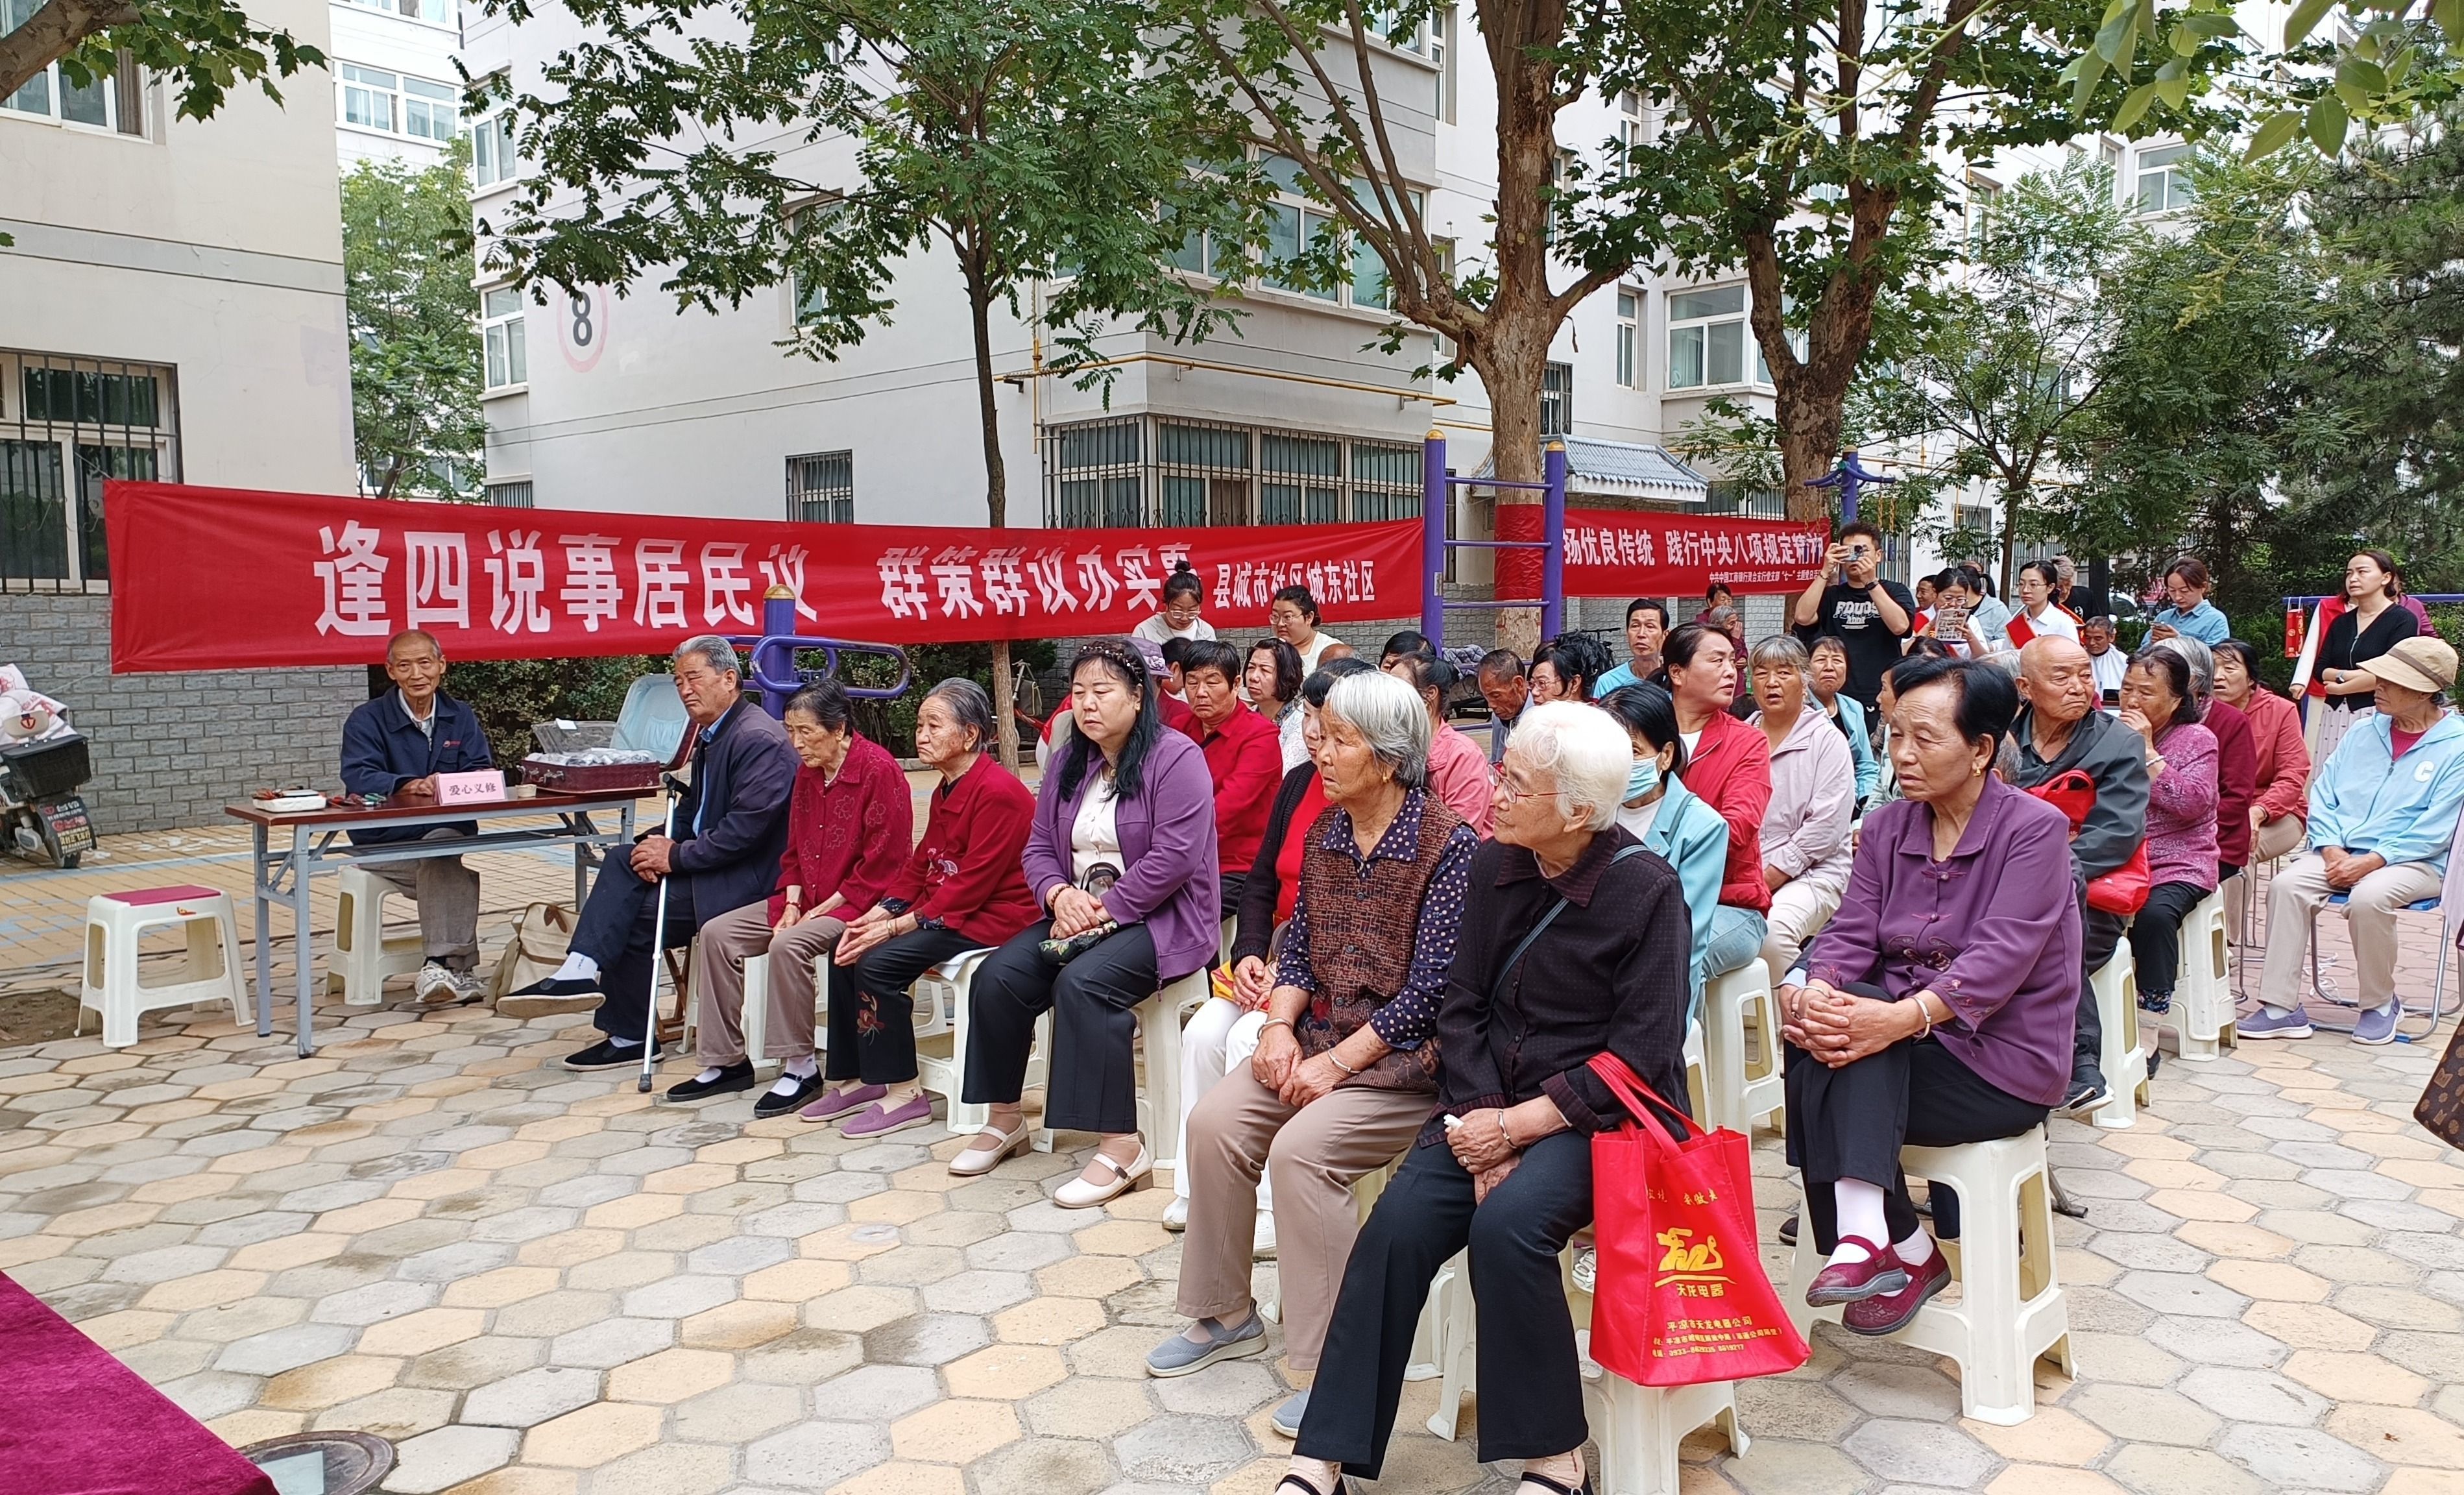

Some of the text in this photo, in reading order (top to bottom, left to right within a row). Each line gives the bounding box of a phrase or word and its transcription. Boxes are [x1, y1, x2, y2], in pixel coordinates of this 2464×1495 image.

[572, 291, 592, 346] 8
[1665, 529, 1824, 567] 践行中央八项规定精神
[313, 520, 817, 637] 逢四说事居民议
[2414, 760, 2435, 782] C
[1676, 1283, 1724, 1298] 天龙电器
[1667, 1315, 1753, 1332] 平凉市天龙电器公司
